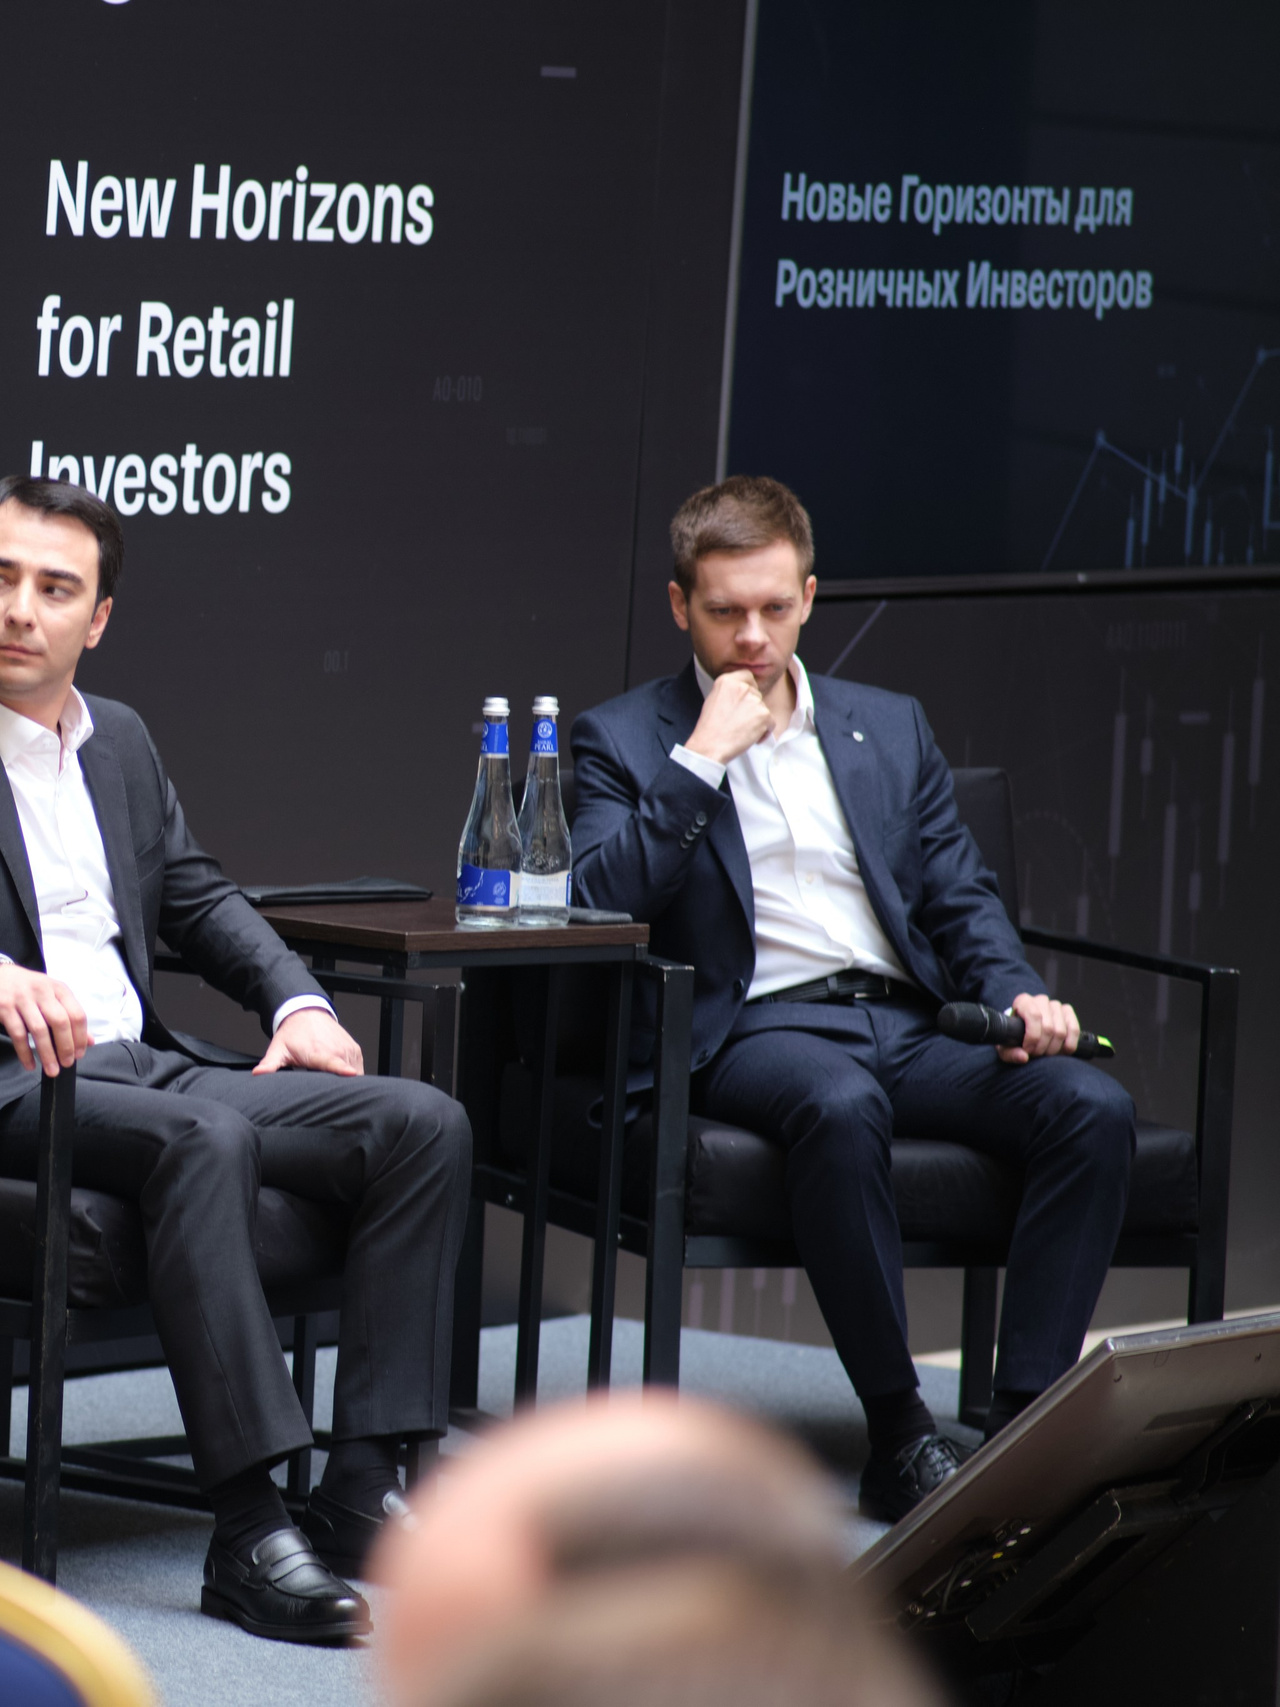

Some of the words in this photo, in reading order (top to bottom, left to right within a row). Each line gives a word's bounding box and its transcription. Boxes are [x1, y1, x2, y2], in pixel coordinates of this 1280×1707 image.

[45, 159, 177, 239] New
[189, 163, 434, 246] Horizons
[781, 172, 892, 223] Новые
[899, 175, 1070, 236] Горизонты
[1073, 187, 1133, 234] для
[775, 259, 960, 309] Розничных
[965, 261, 1152, 320] Инвесторов
[36, 294, 122, 378] for
[136, 298, 294, 378] Retail
